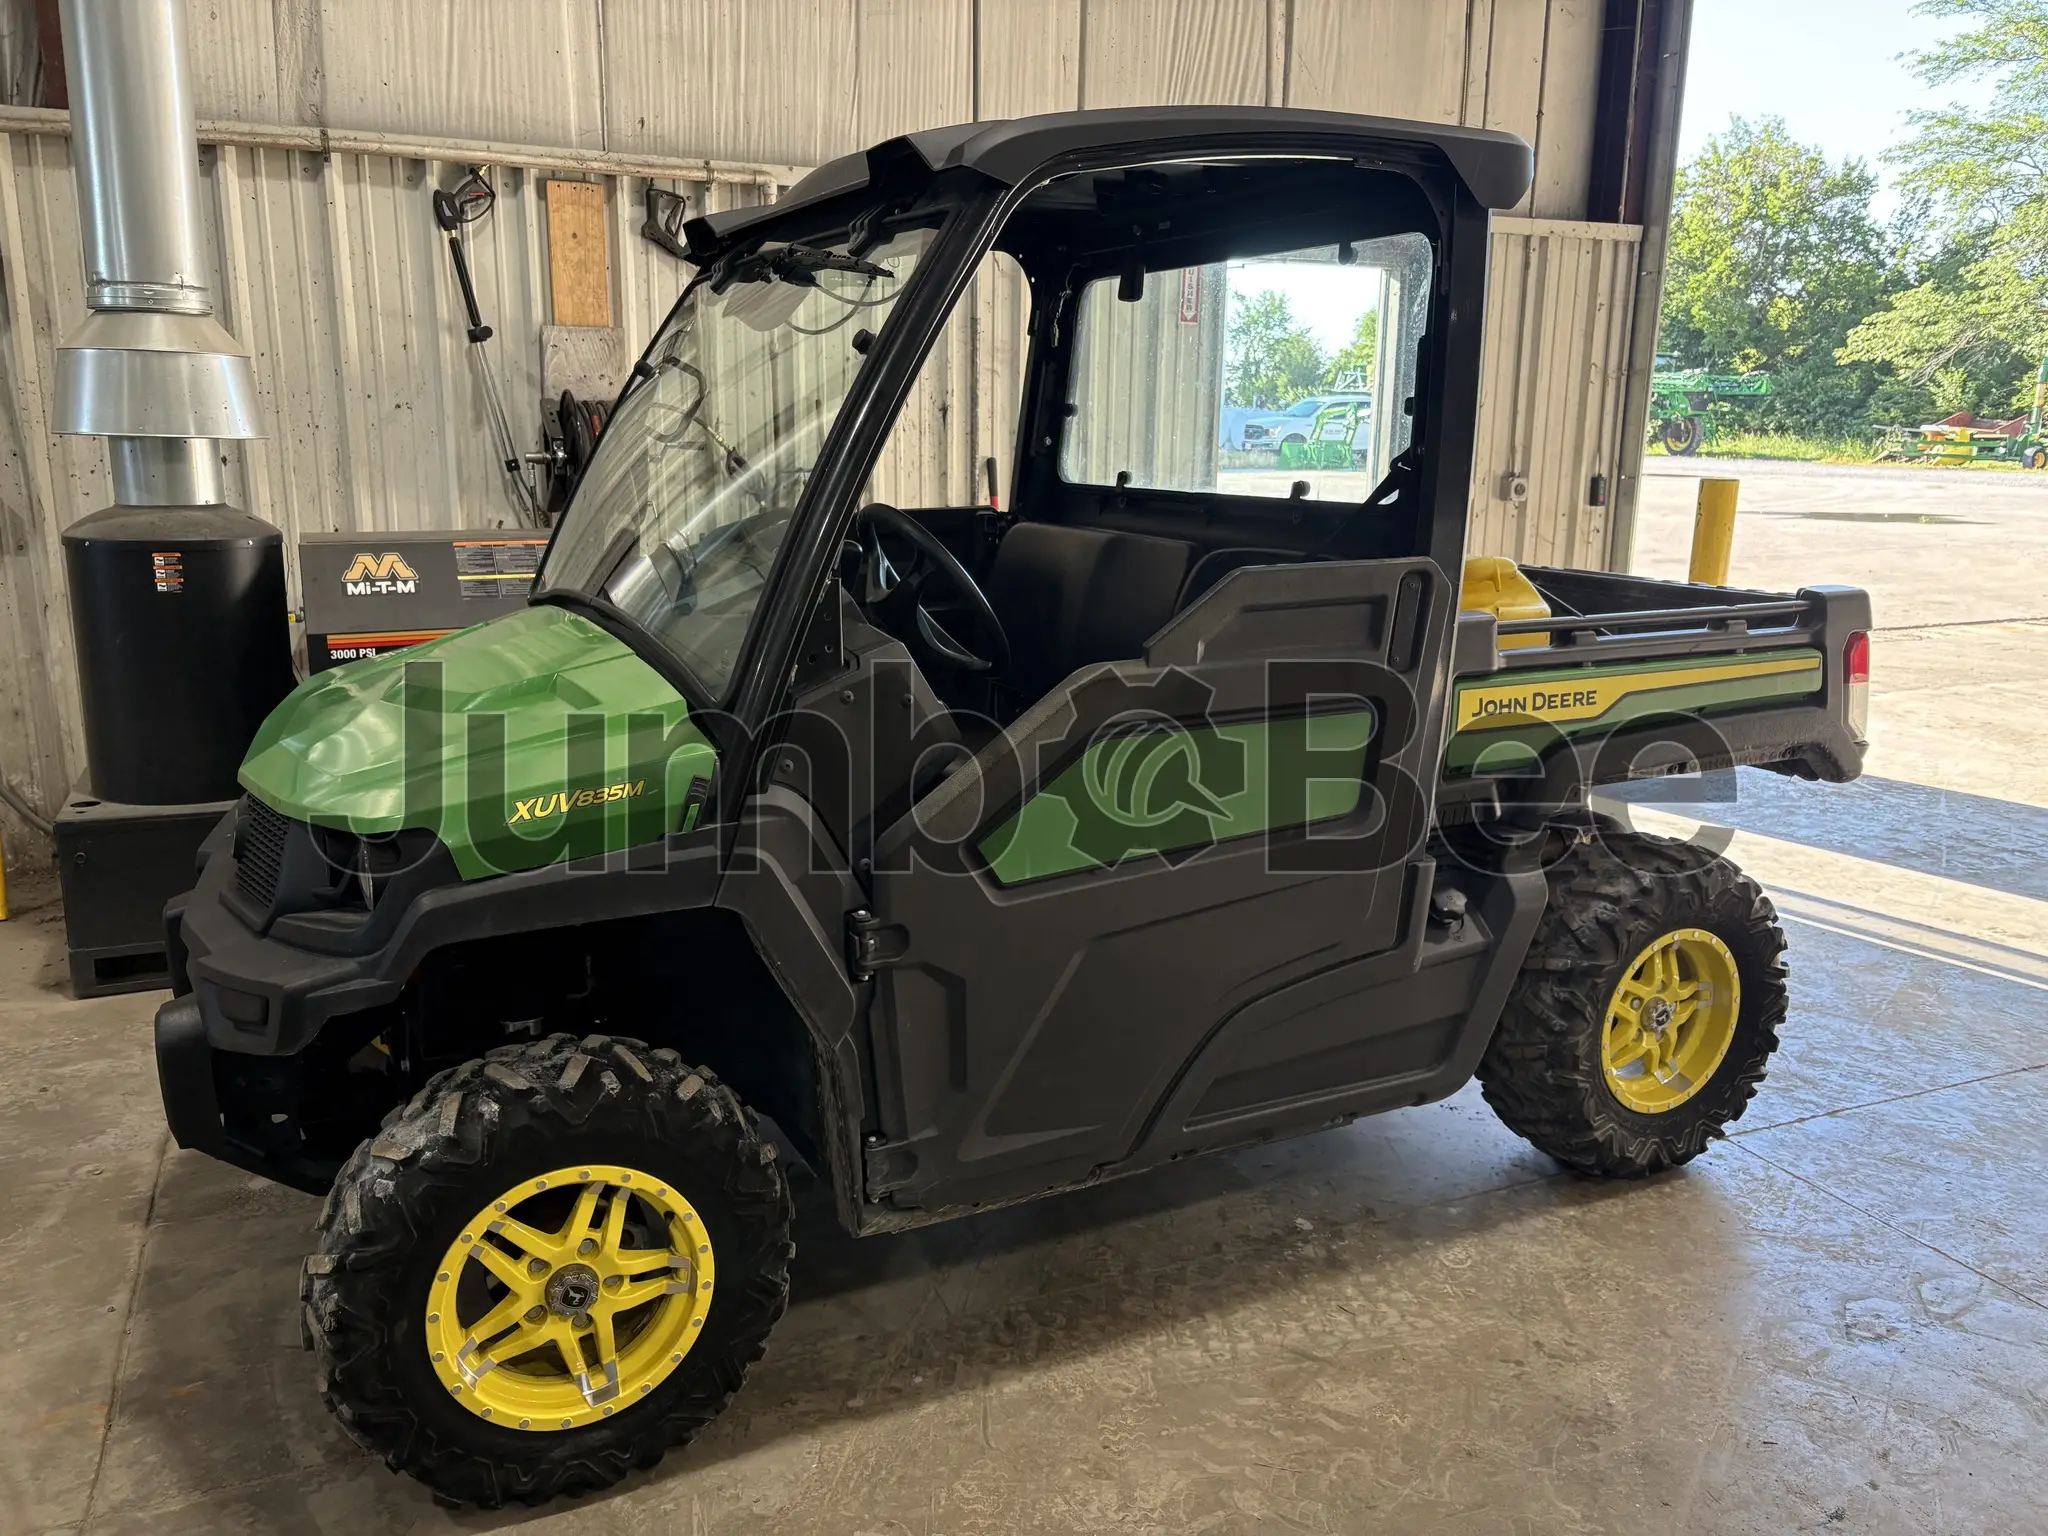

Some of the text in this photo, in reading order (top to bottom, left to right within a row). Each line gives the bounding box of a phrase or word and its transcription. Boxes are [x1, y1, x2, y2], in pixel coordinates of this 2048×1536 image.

[346, 580, 416, 596] Mi-T-M
[330, 648, 376, 660] 3000 PSI
[1472, 690, 1598, 718] JOHN DEERE
[504, 779, 646, 825] XUV835M
